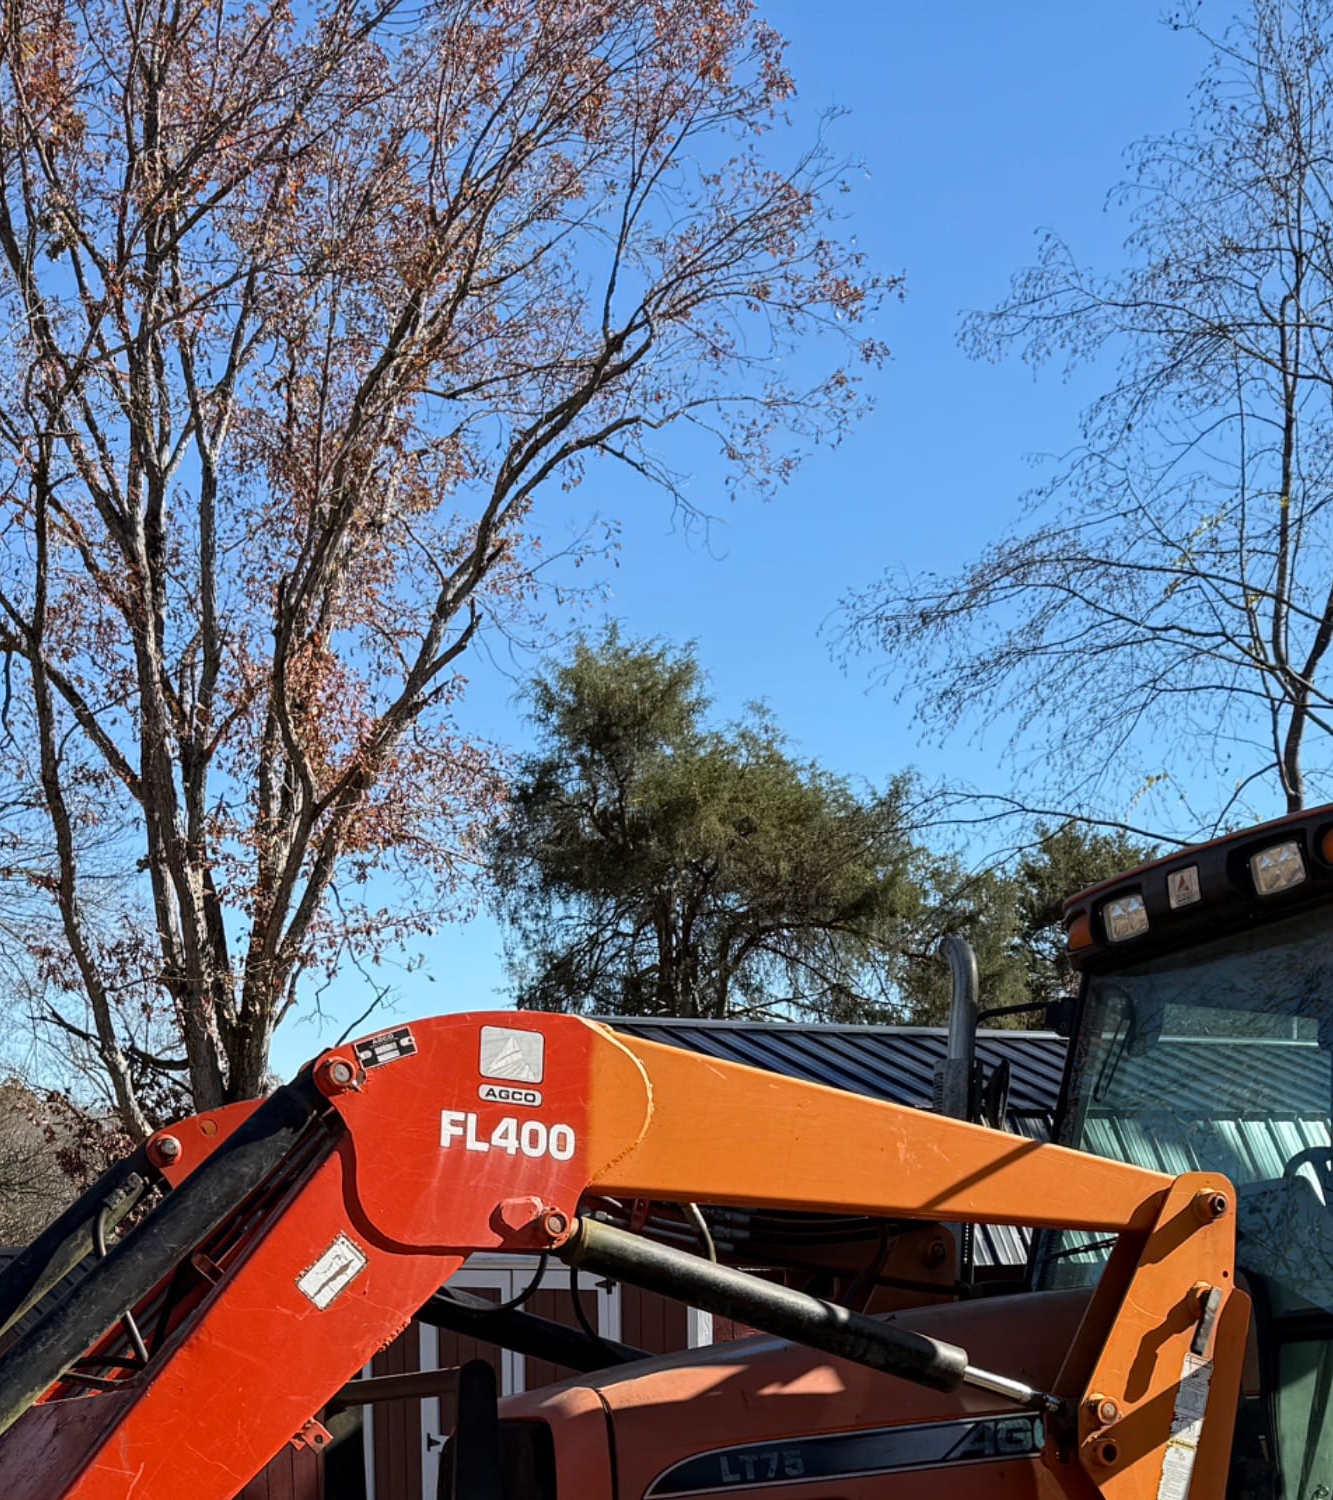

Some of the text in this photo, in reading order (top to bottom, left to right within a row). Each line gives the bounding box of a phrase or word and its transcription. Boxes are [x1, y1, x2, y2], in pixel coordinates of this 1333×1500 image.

[485, 1087, 537, 1104] AGCO
[439, 1109, 576, 1161] FL400
[719, 1449, 805, 1483] LT75
